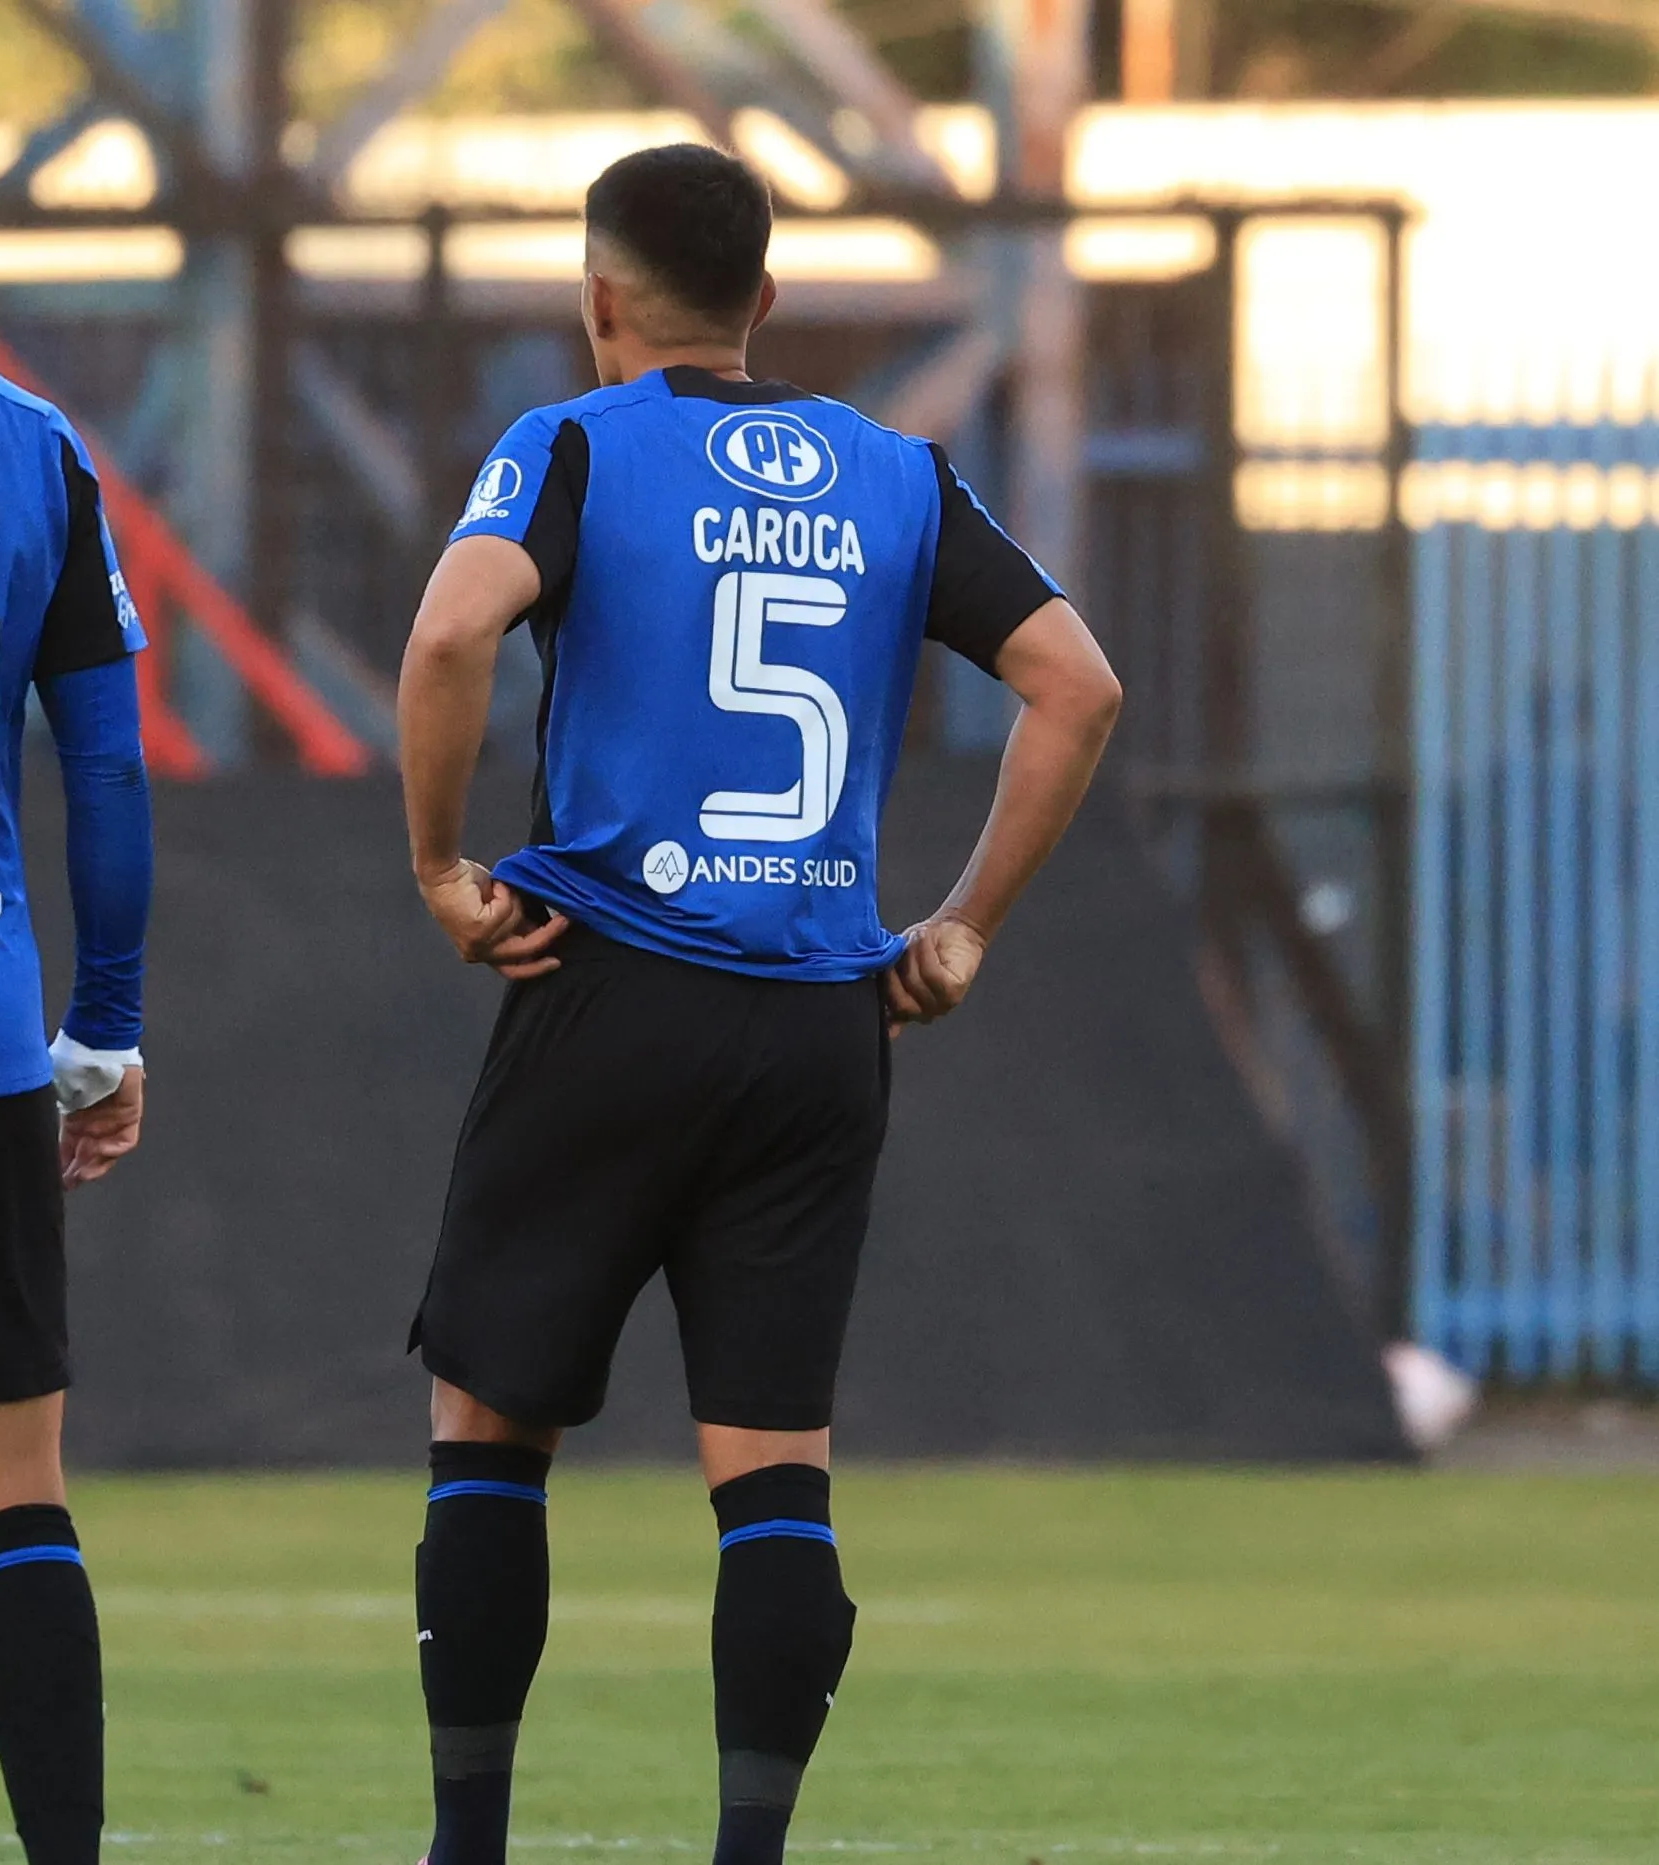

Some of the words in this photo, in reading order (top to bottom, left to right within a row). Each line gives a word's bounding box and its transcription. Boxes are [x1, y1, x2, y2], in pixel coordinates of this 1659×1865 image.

[741, 424, 803, 482] PF
[693, 507, 865, 575] CAROCA
[699, 571, 849, 842] 5
[690, 855, 797, 885] ANDES
